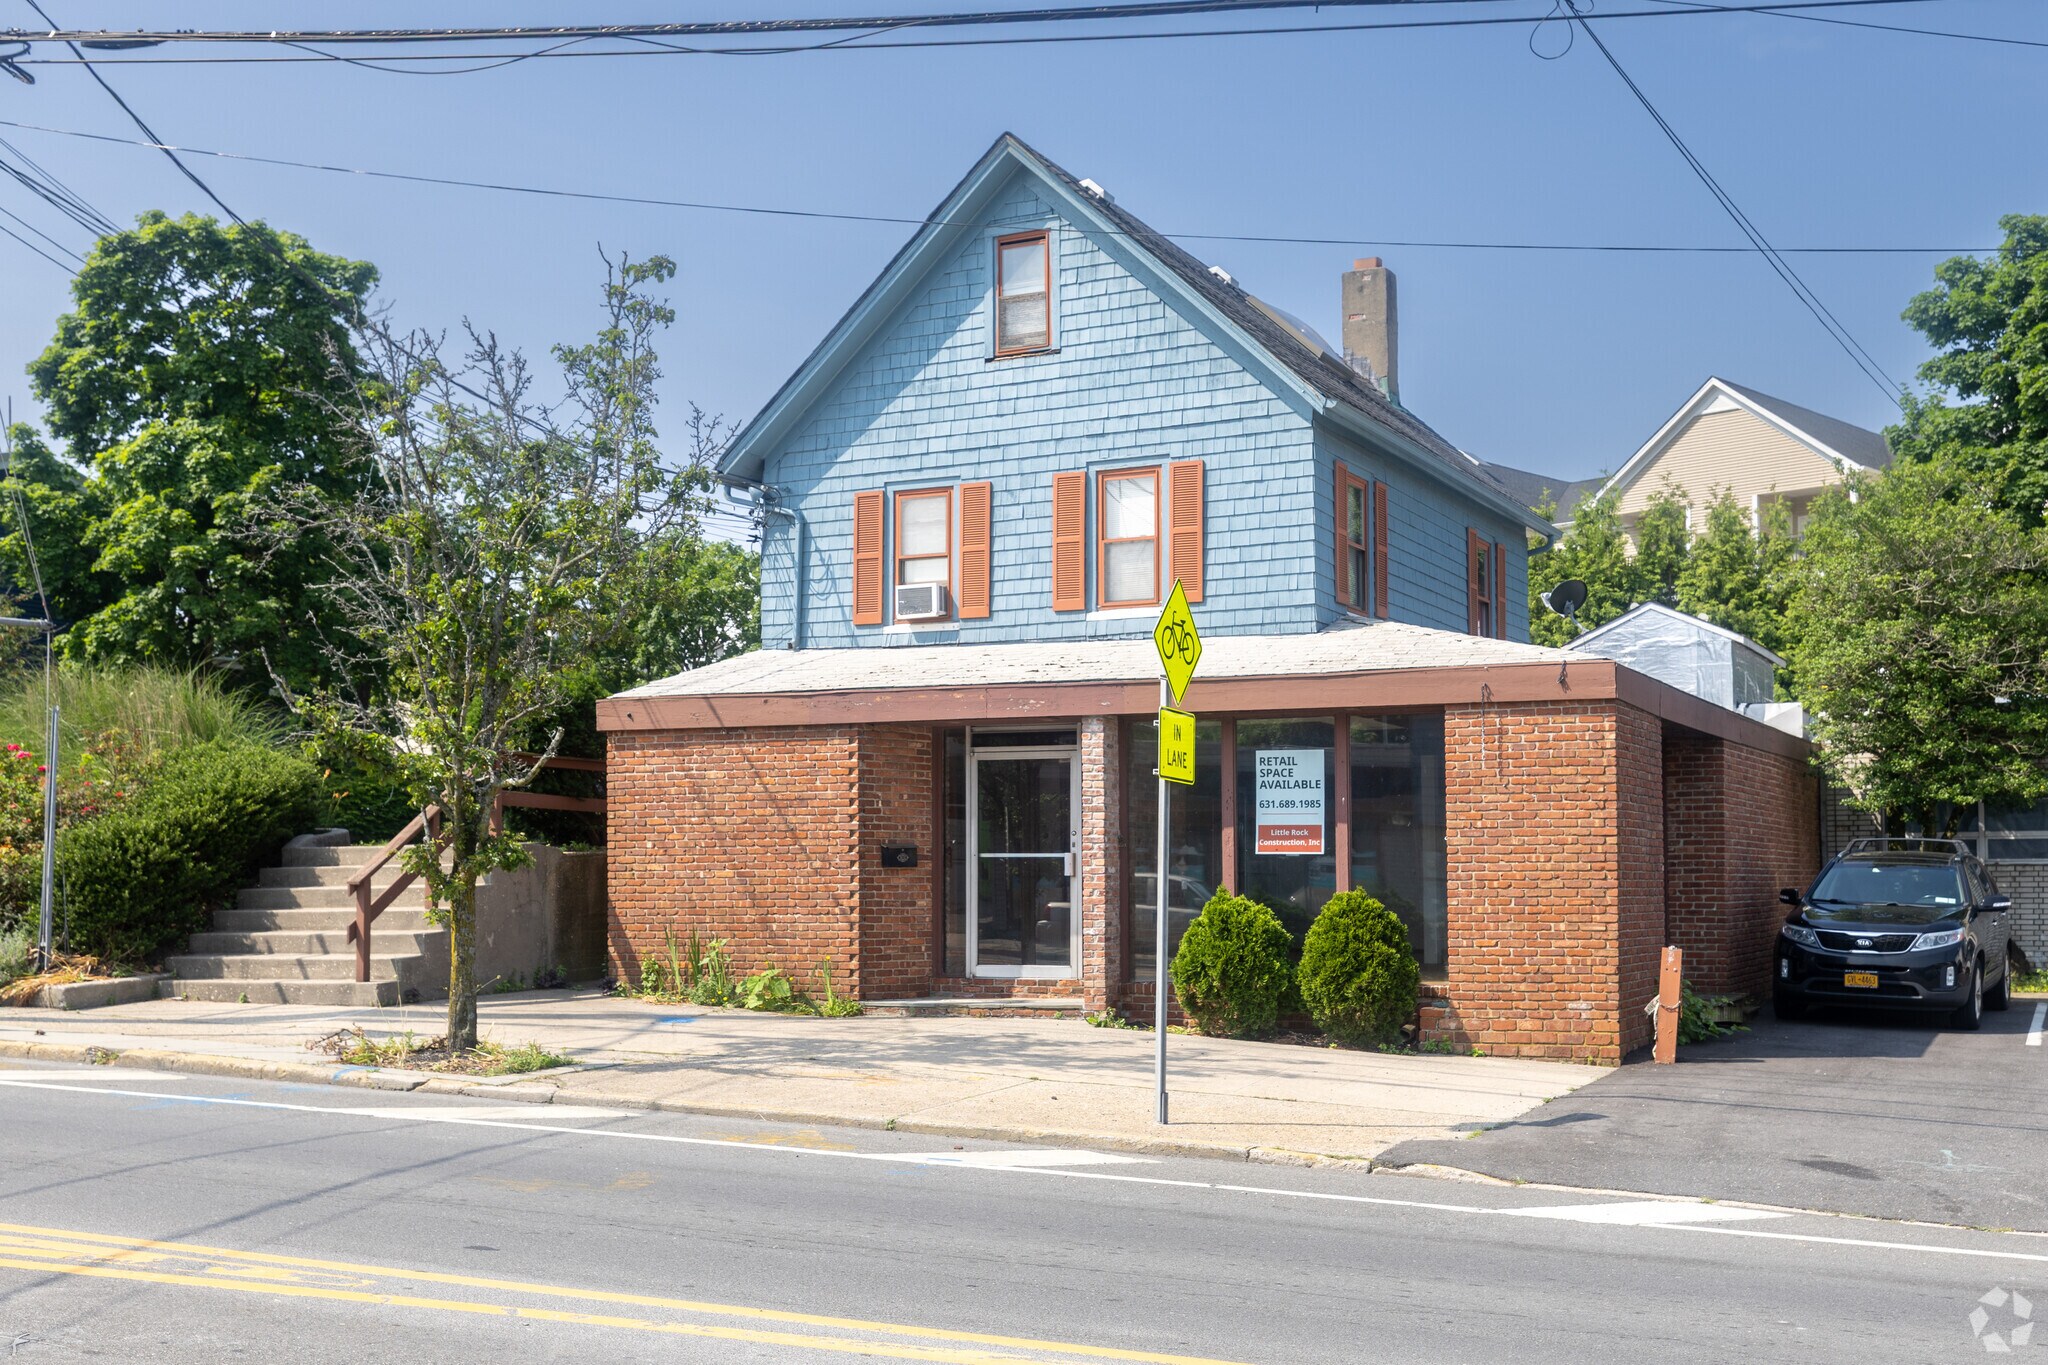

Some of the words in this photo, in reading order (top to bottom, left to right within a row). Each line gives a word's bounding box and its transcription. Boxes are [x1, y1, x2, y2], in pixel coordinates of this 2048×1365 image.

[1173, 723, 1182, 742] IN
[1167, 748, 1188, 769] LANE
[1259, 756, 1298, 766] RETAIL
[1259, 768, 1294, 778] SPACE
[1259, 779, 1322, 790] AVAILABLE
[1259, 799, 1322, 809] 631.689.1985
[1259, 838, 1307, 847] Construction,
[1308, 838, 1320, 846] Inc
